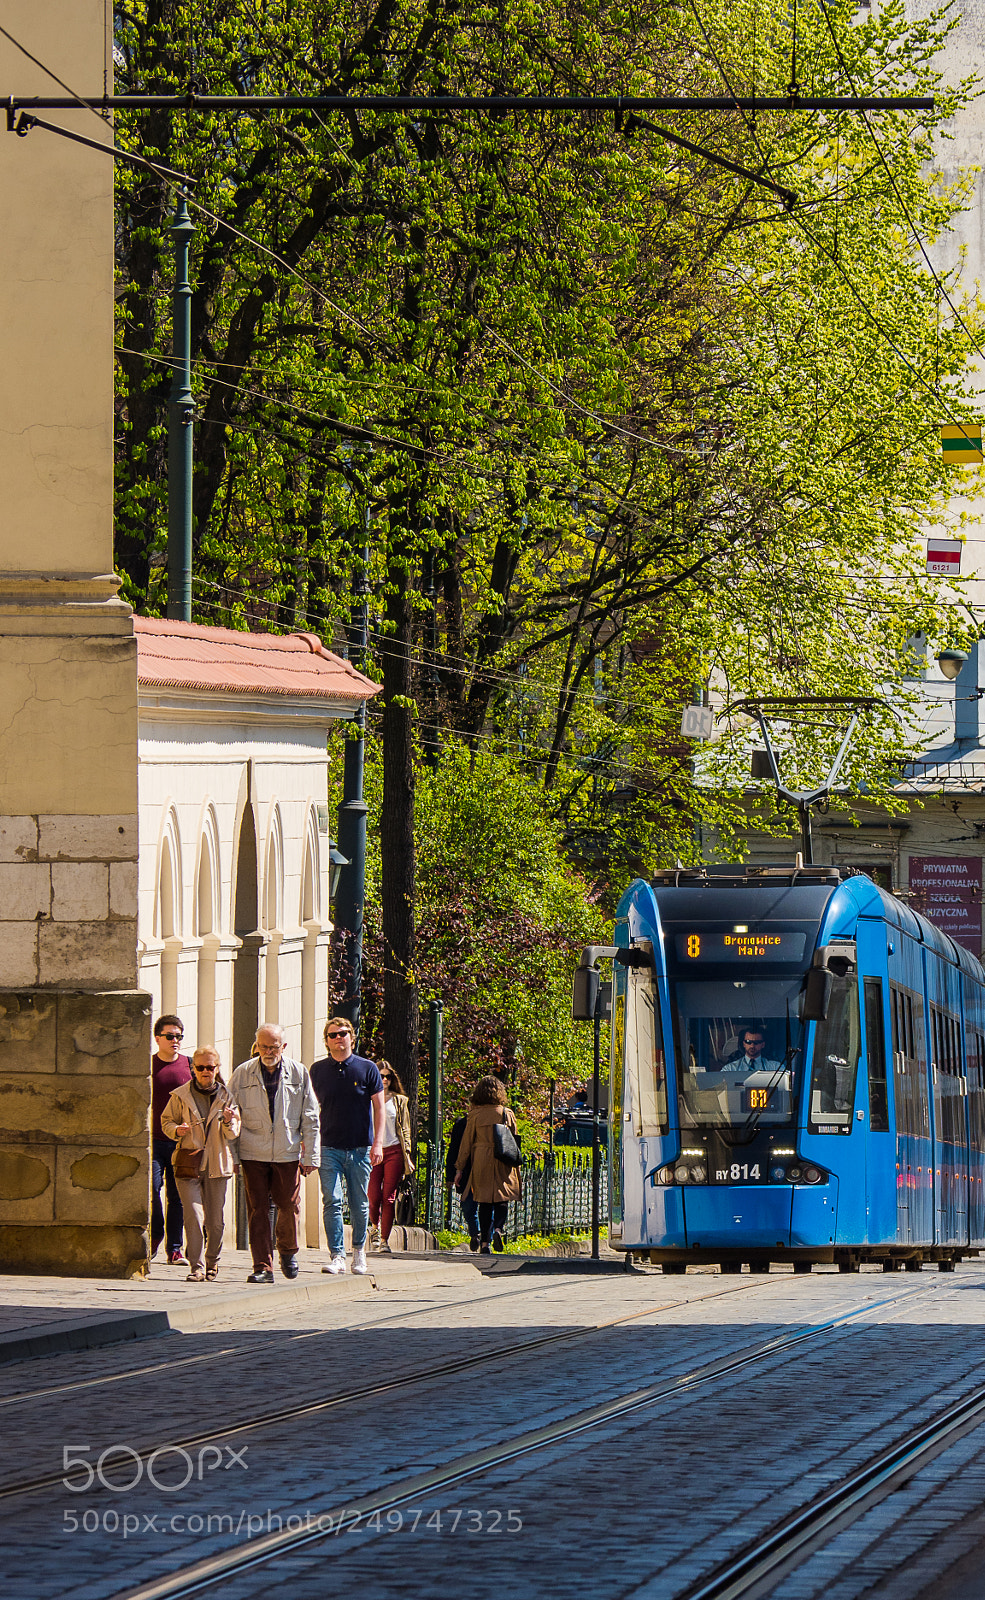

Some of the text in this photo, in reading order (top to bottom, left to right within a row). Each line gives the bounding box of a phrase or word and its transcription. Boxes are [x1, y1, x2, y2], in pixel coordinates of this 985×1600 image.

[923, 864, 968, 873] PRYWATNA
[911, 879, 980, 888] PROFESJONALNA
[687, 934, 700, 958] 8
[723, 935, 781, 946] Bronowice
[715, 1163, 761, 1180] RY 814
